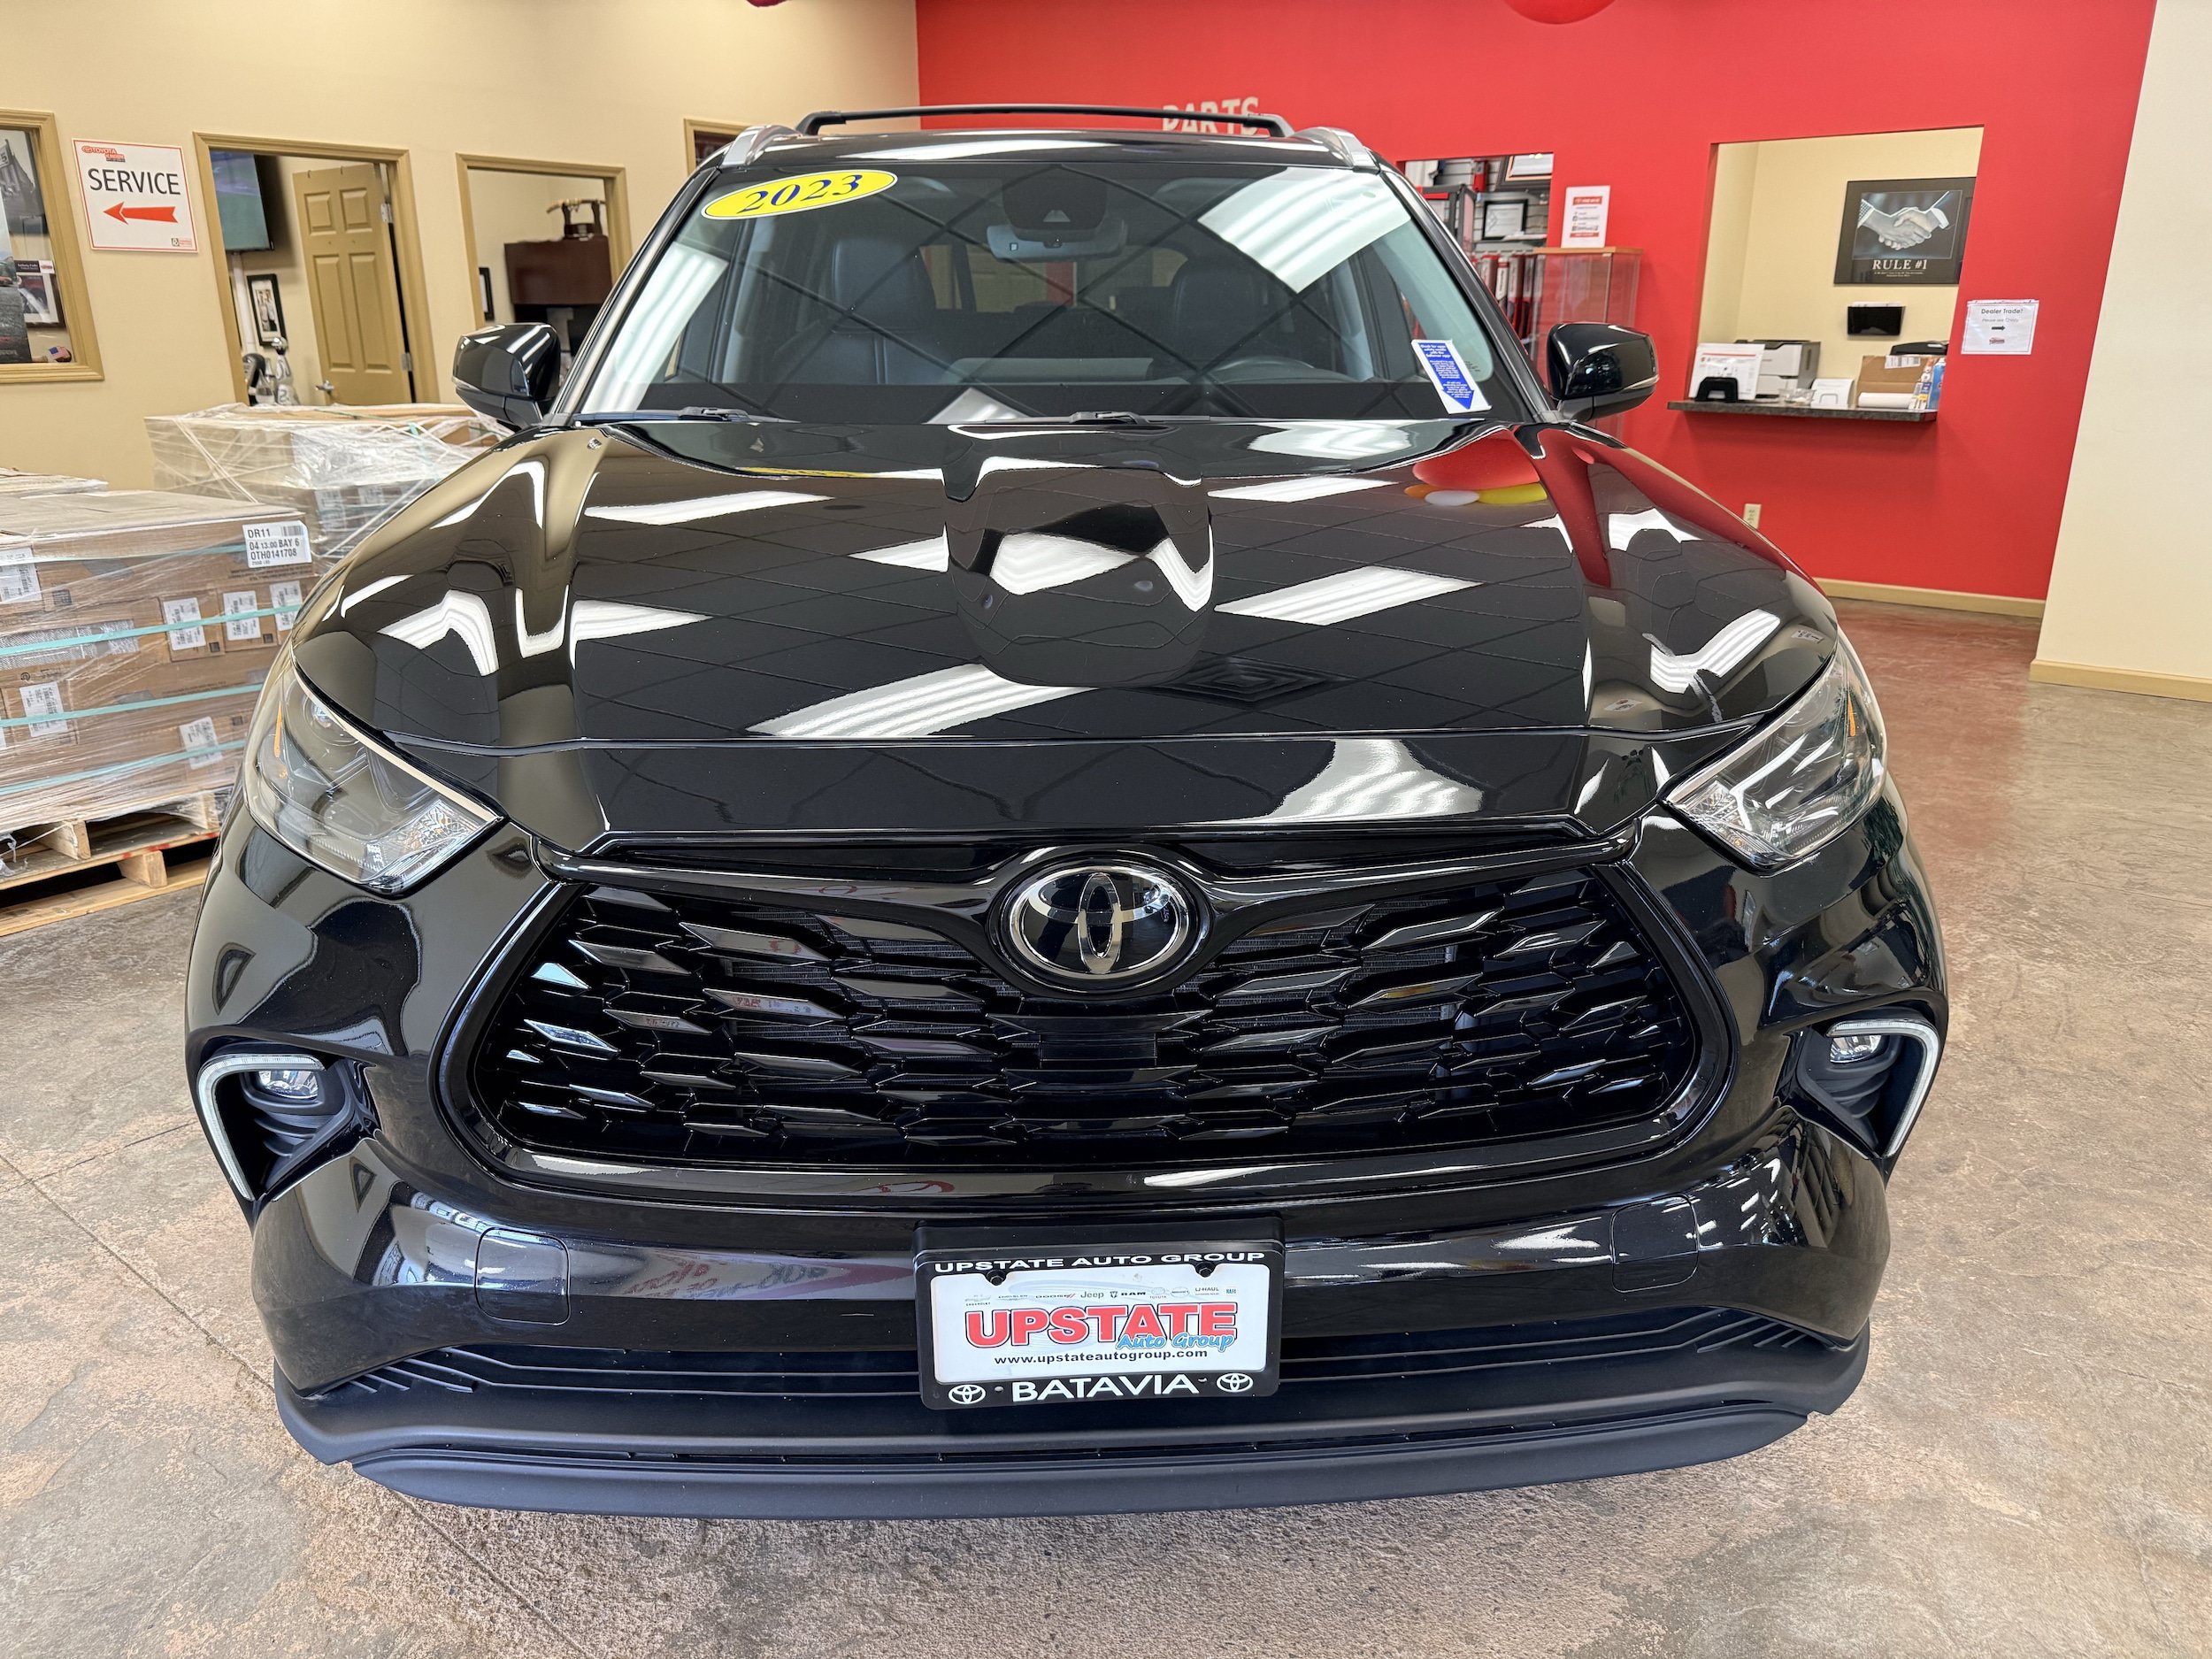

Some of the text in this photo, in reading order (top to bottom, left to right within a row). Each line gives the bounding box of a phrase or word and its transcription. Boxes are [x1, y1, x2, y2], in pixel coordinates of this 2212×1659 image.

[1162, 96, 1259, 135] PARTS
[88, 168, 181, 195] SERVICE
[735, 174, 864, 214] 2023
[1872, 259, 1927, 270] RULE #1
[248, 528, 270, 538] DR11
[250, 541, 259, 550] 04
[279, 539, 292, 549] BAY
[295, 538, 300, 547] 6
[935, 1252, 1265, 1272] UPSTATE AUTO GROUP
[965, 1302, 1238, 1348] UPSTATE
[1116, 1333, 1235, 1353] Auto Group
[995, 1350, 1208, 1365] www.upstateautogroup.com
[1012, 1373, 1200, 1402] BATAVIA
